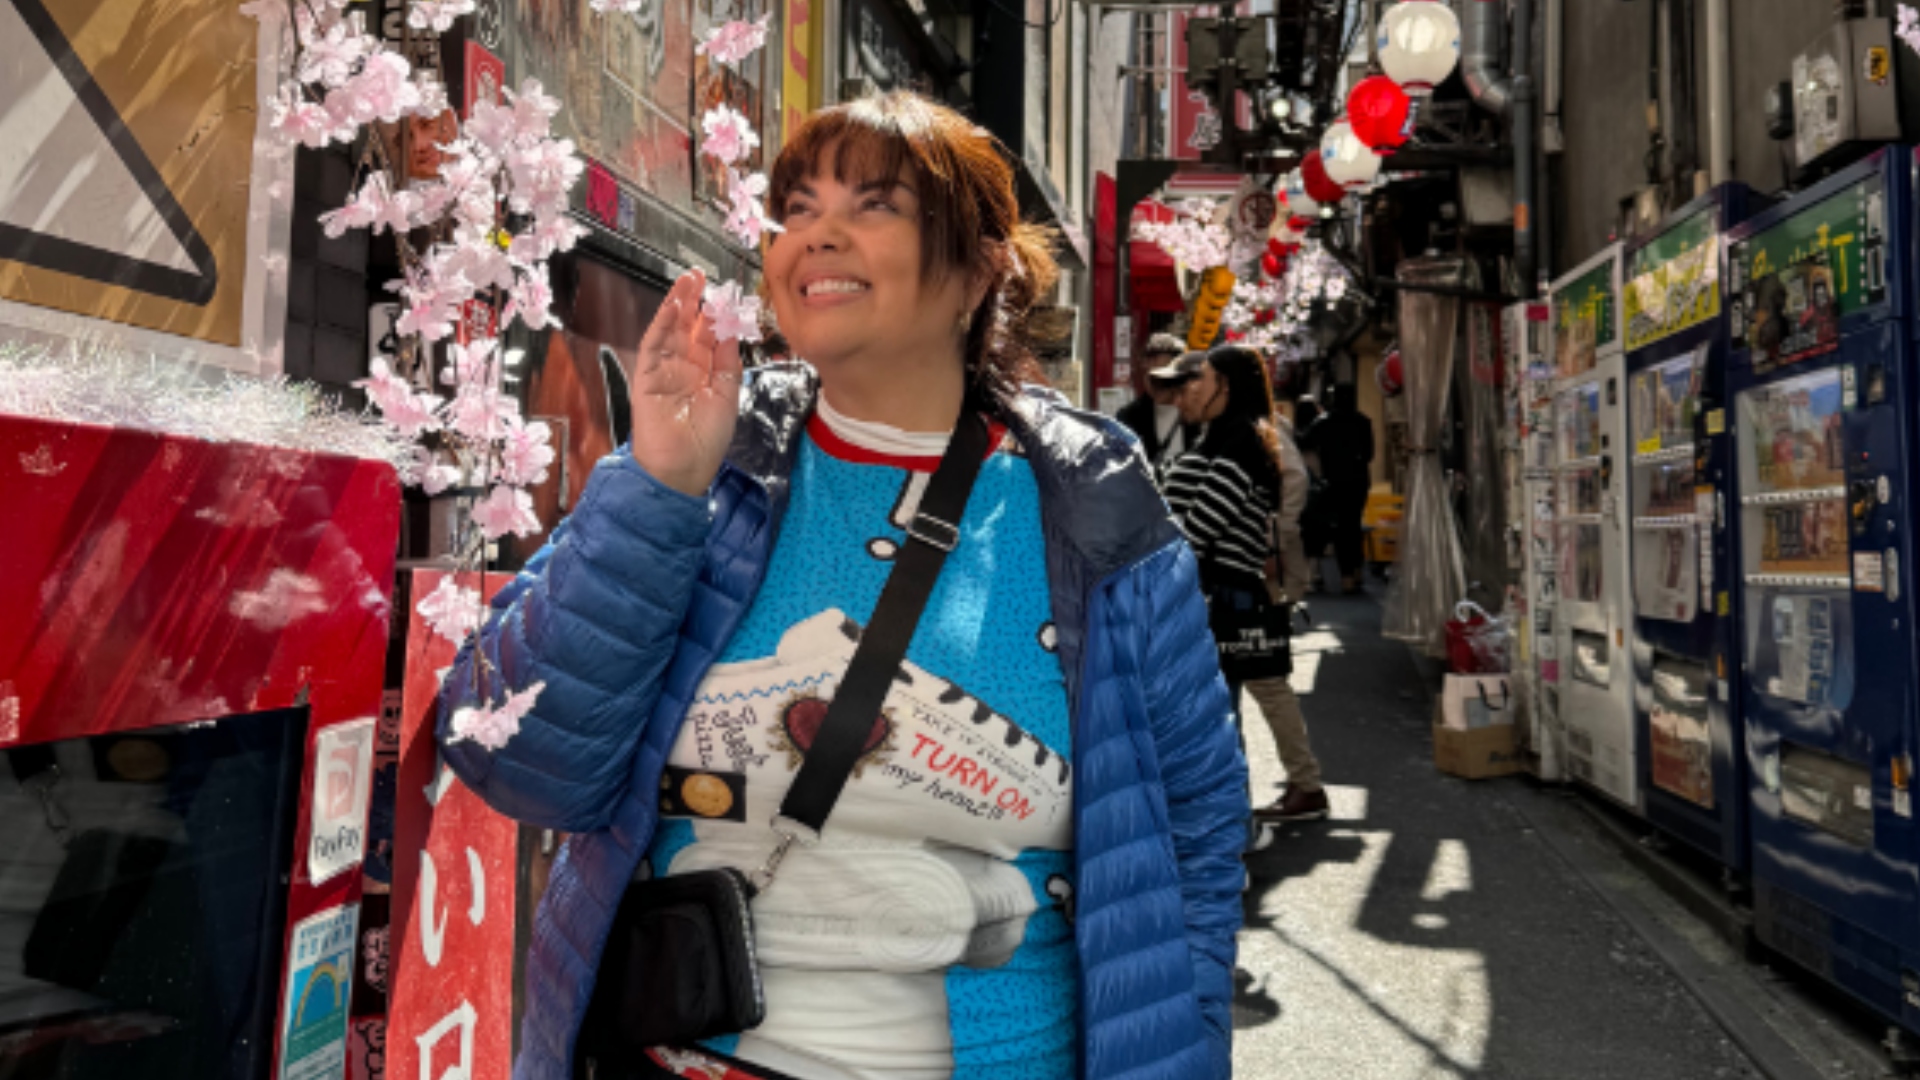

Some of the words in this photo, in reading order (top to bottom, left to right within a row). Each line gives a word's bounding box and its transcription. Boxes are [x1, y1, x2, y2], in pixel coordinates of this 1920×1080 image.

[882, 763, 924, 789] my
[911, 732, 998, 796] TURN
[996, 787, 1036, 821] ON
